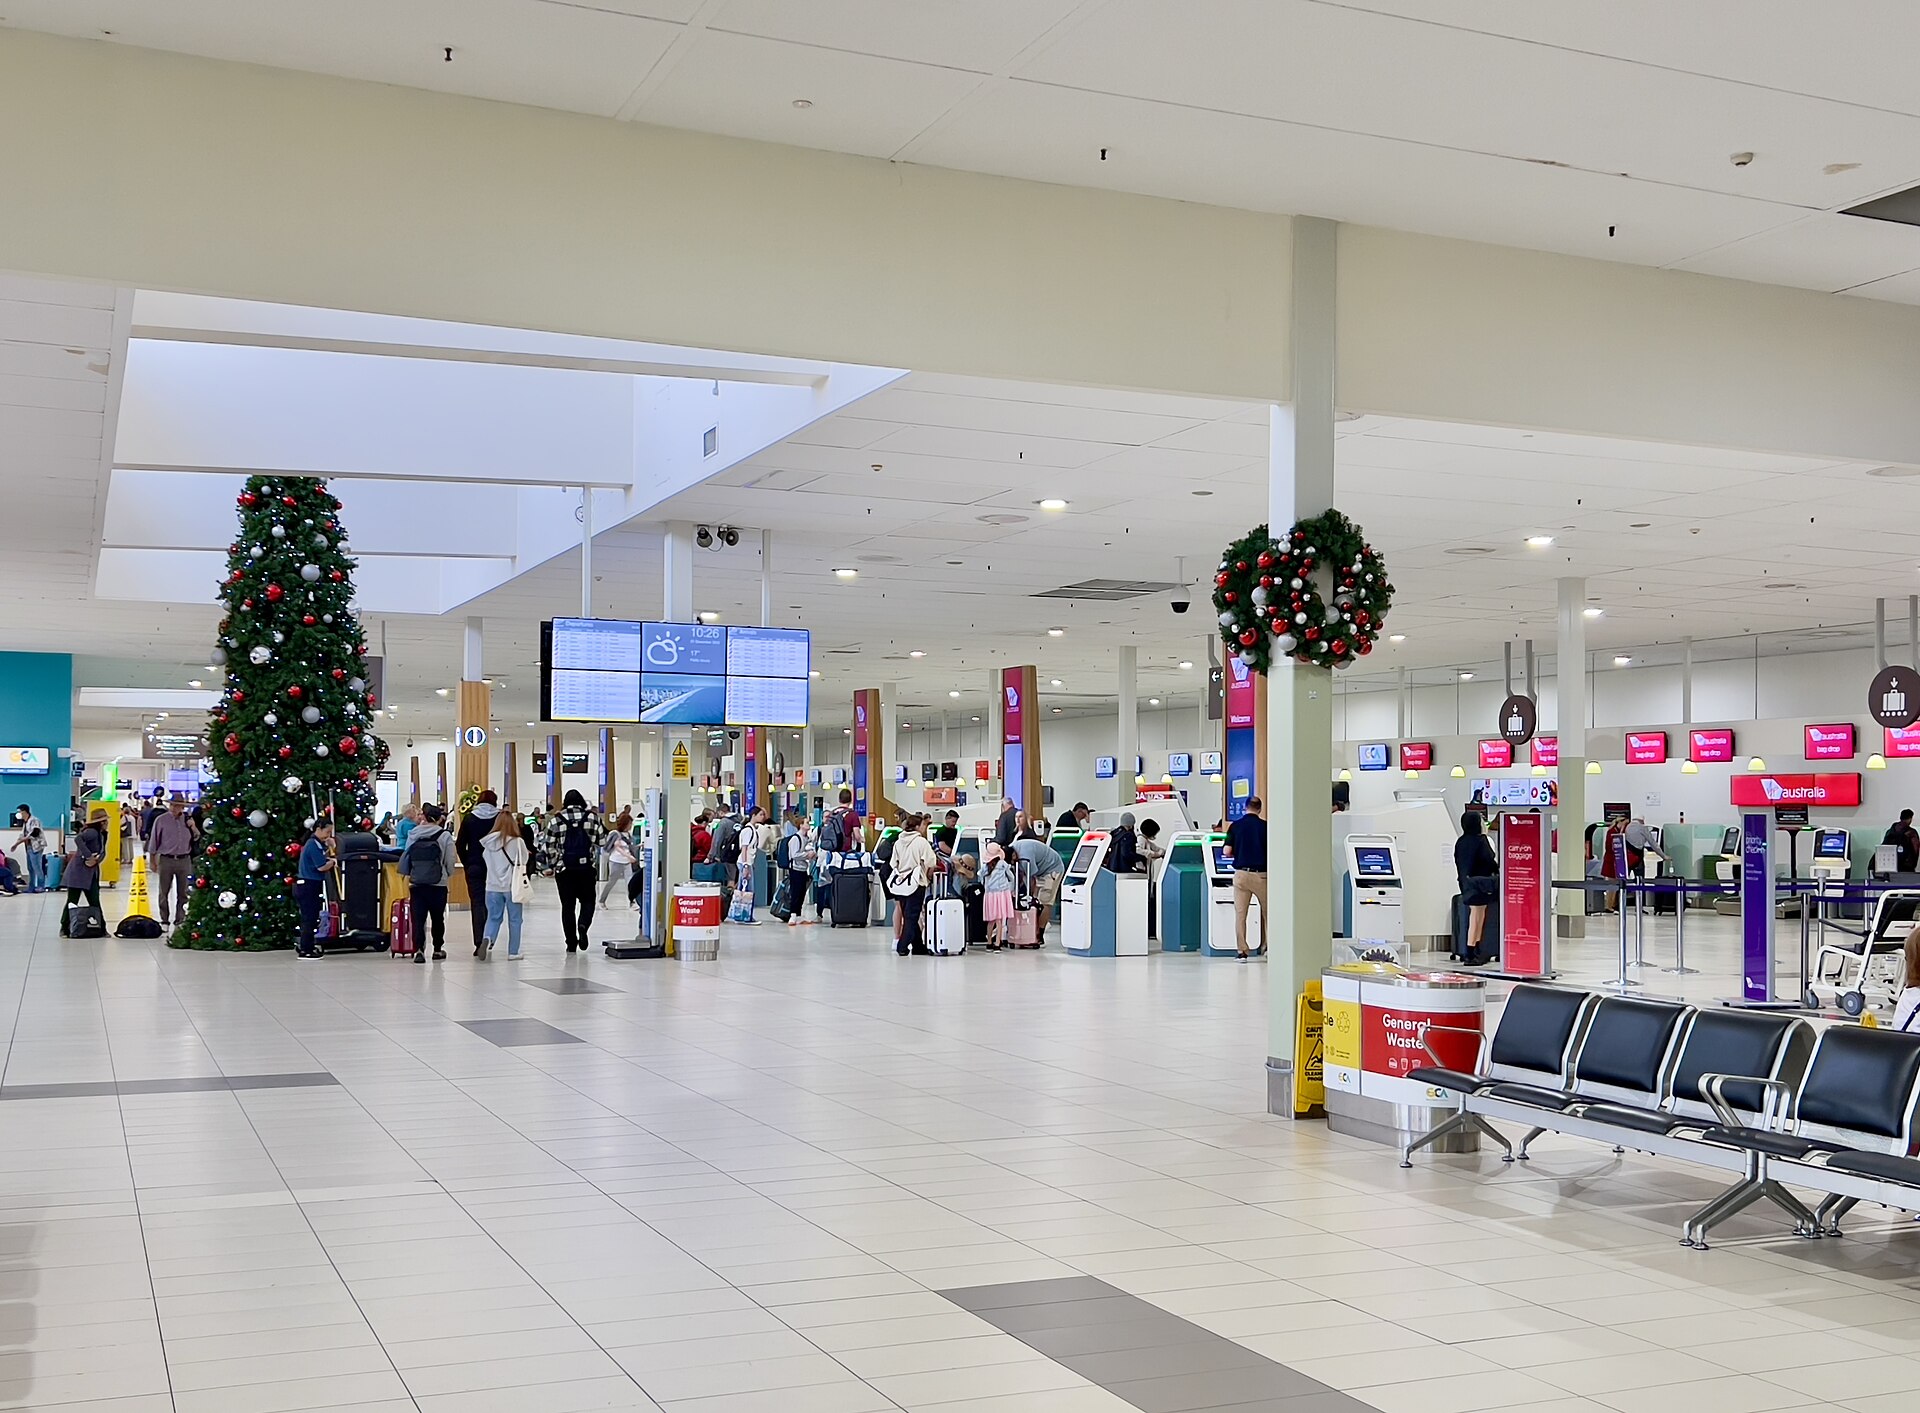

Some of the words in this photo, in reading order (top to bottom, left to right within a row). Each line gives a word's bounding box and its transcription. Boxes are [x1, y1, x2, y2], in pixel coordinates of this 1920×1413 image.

[691, 627, 720, 639] 10:26
[9, 750, 38, 764] GCA
[1782, 786, 1826, 799] australia
[1508, 845, 1532, 853] carry-on
[1508, 852, 1533, 860] baggage
[678, 898, 704, 906] General
[1382, 1013, 1431, 1032] General
[1386, 1031, 1425, 1050] Waste
[1426, 1087, 1449, 1098] GCA
